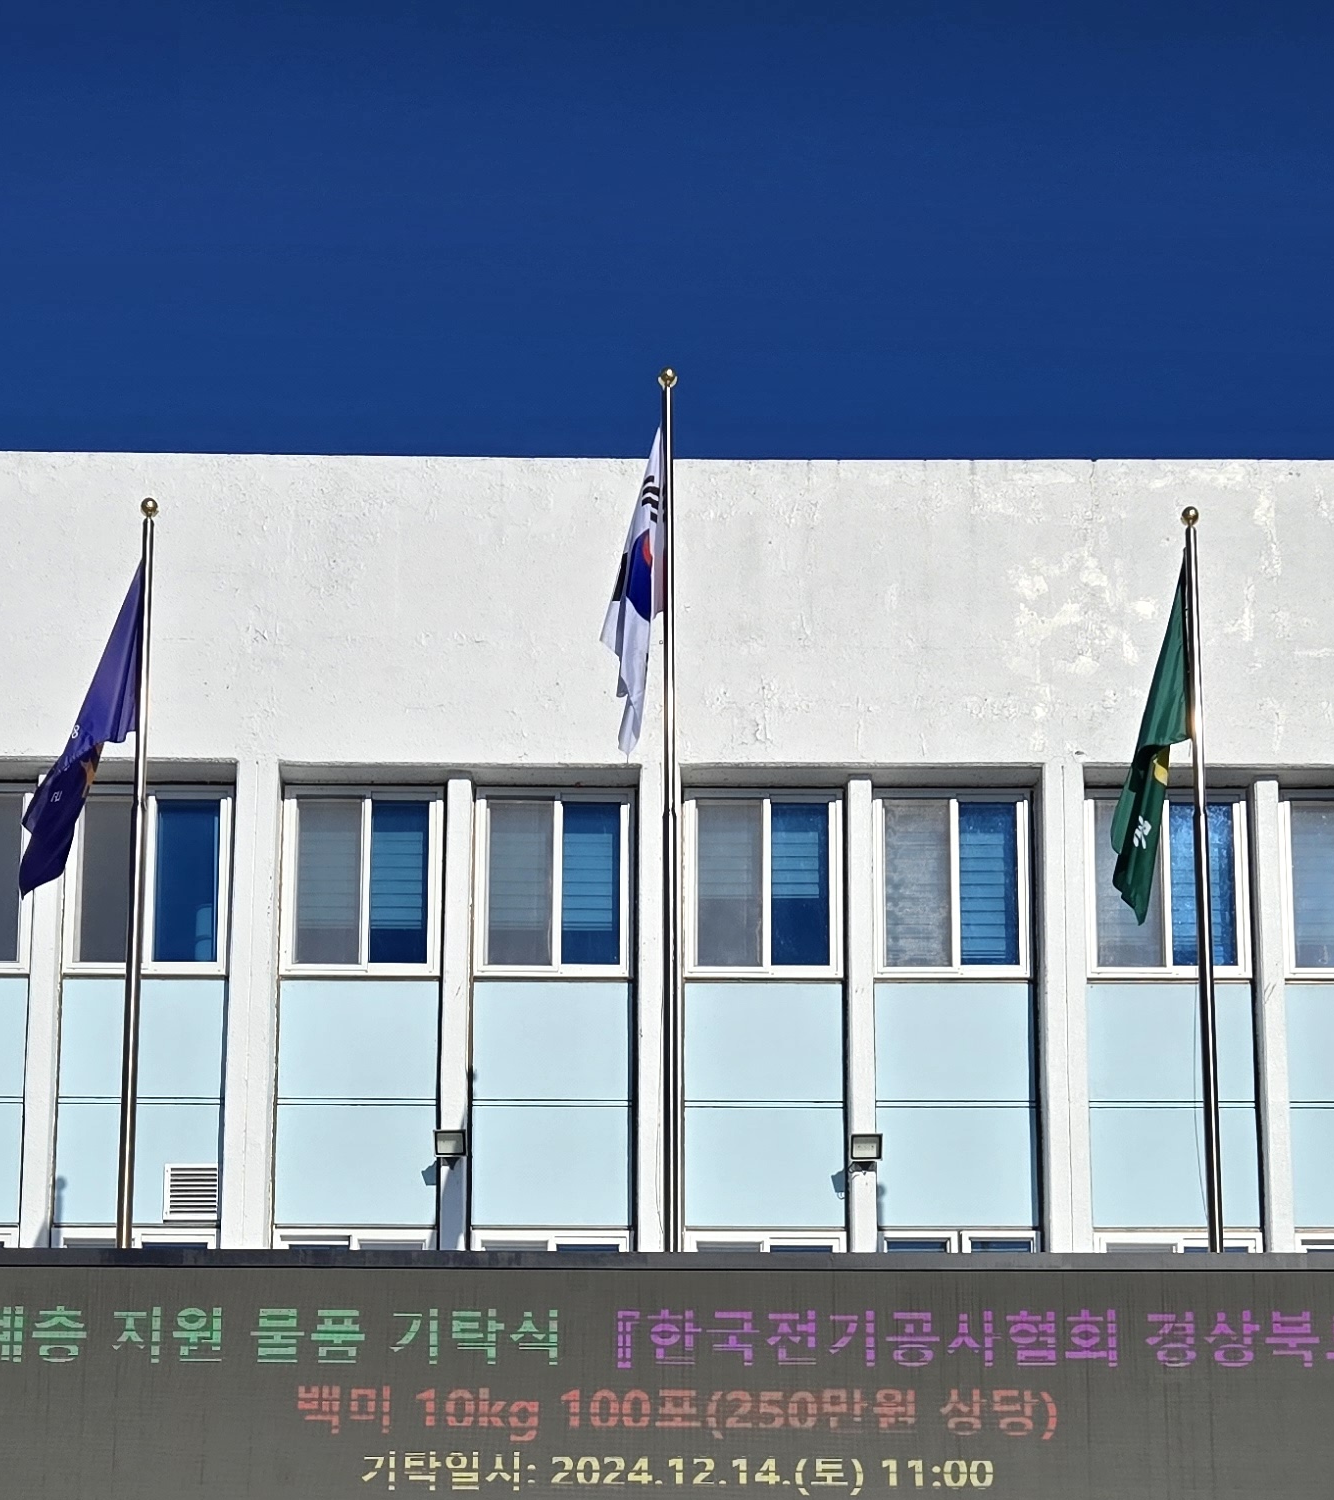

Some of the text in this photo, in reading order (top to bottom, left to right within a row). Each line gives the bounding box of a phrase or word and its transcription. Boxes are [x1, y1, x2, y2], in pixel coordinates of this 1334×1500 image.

[111, 1306, 223, 1363] 지원
[250, 1308, 365, 1364] 물품
[389, 1308, 559, 1366] 기탁식
[297, 1385, 1058, 1442] 백미 10kg 100포(250만원 상당)
[361, 1450, 994, 1496] 기탁일시: 2024.12.14.(토) 11:00
